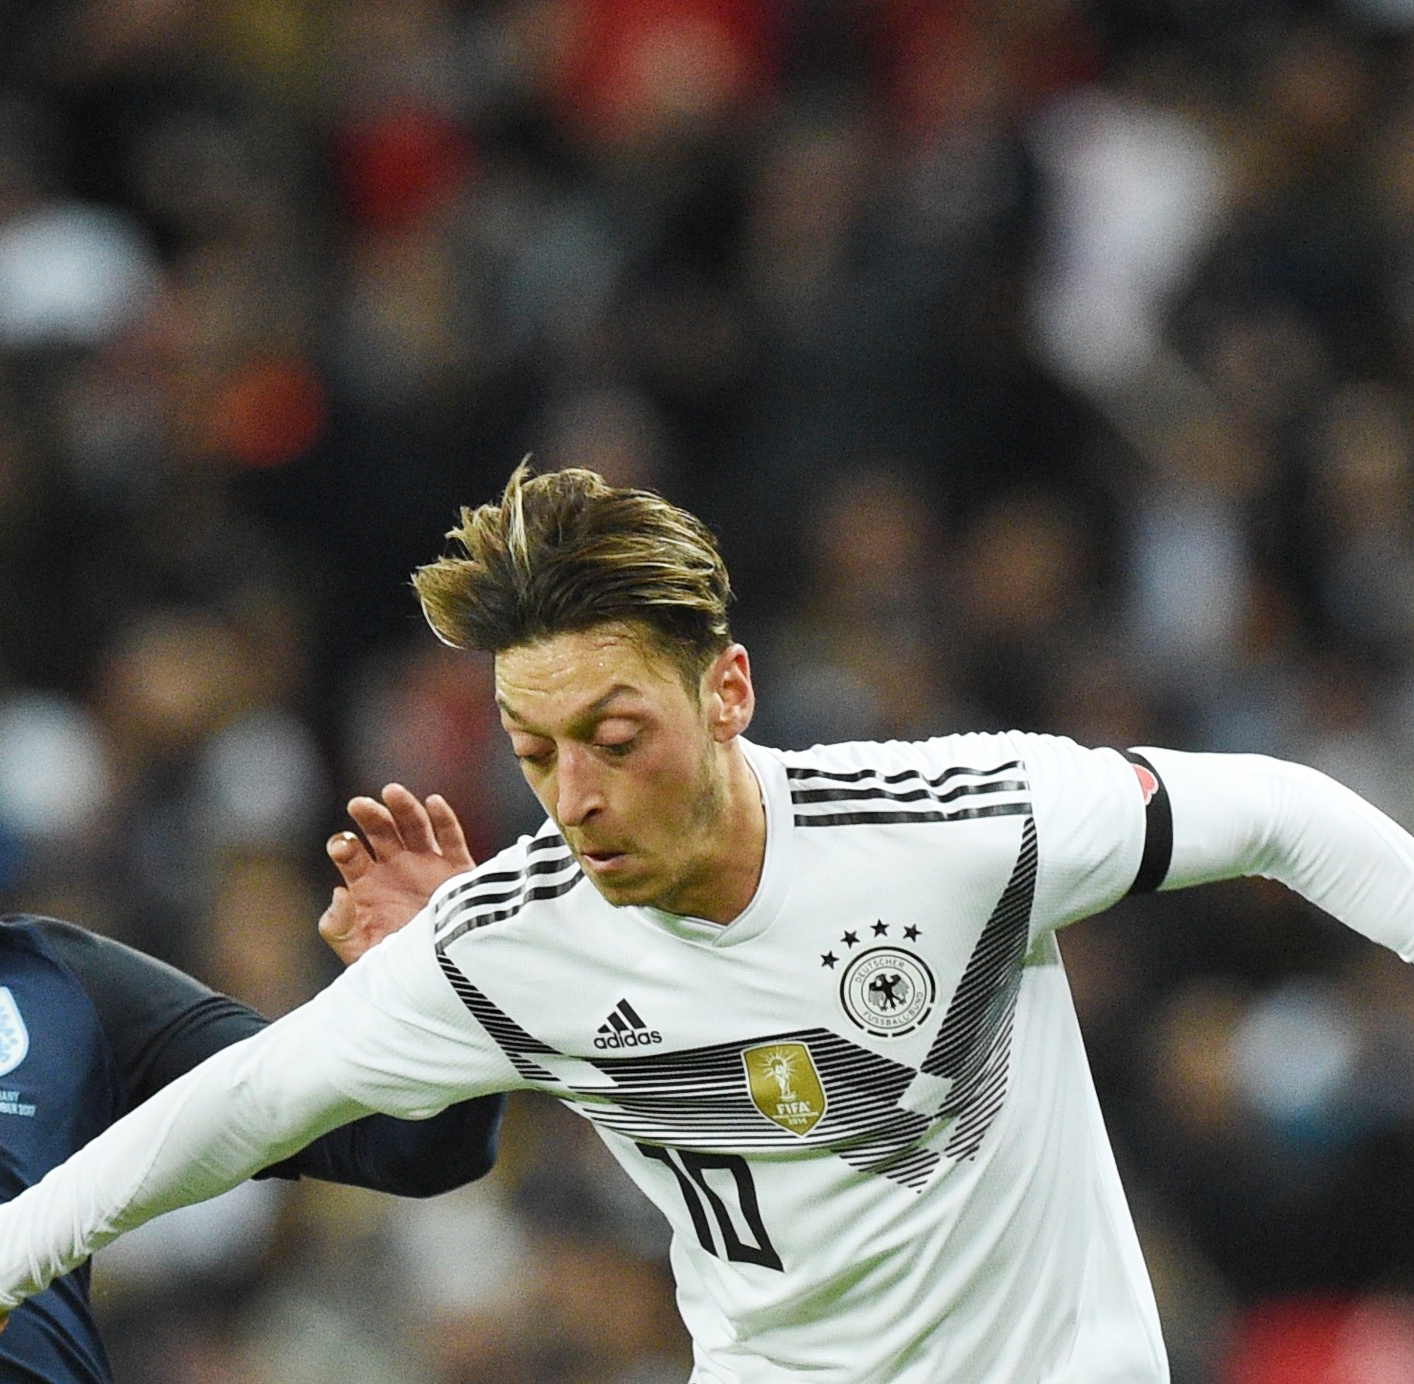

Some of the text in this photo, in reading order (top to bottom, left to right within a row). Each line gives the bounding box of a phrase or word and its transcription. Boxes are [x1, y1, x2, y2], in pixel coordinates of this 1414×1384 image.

[854, 957, 906, 984] DEUTSCHER
[593, 1029, 663, 1049] adidas
[776, 1101, 810, 1115] FIFA
[634, 1142, 785, 1273] 10
